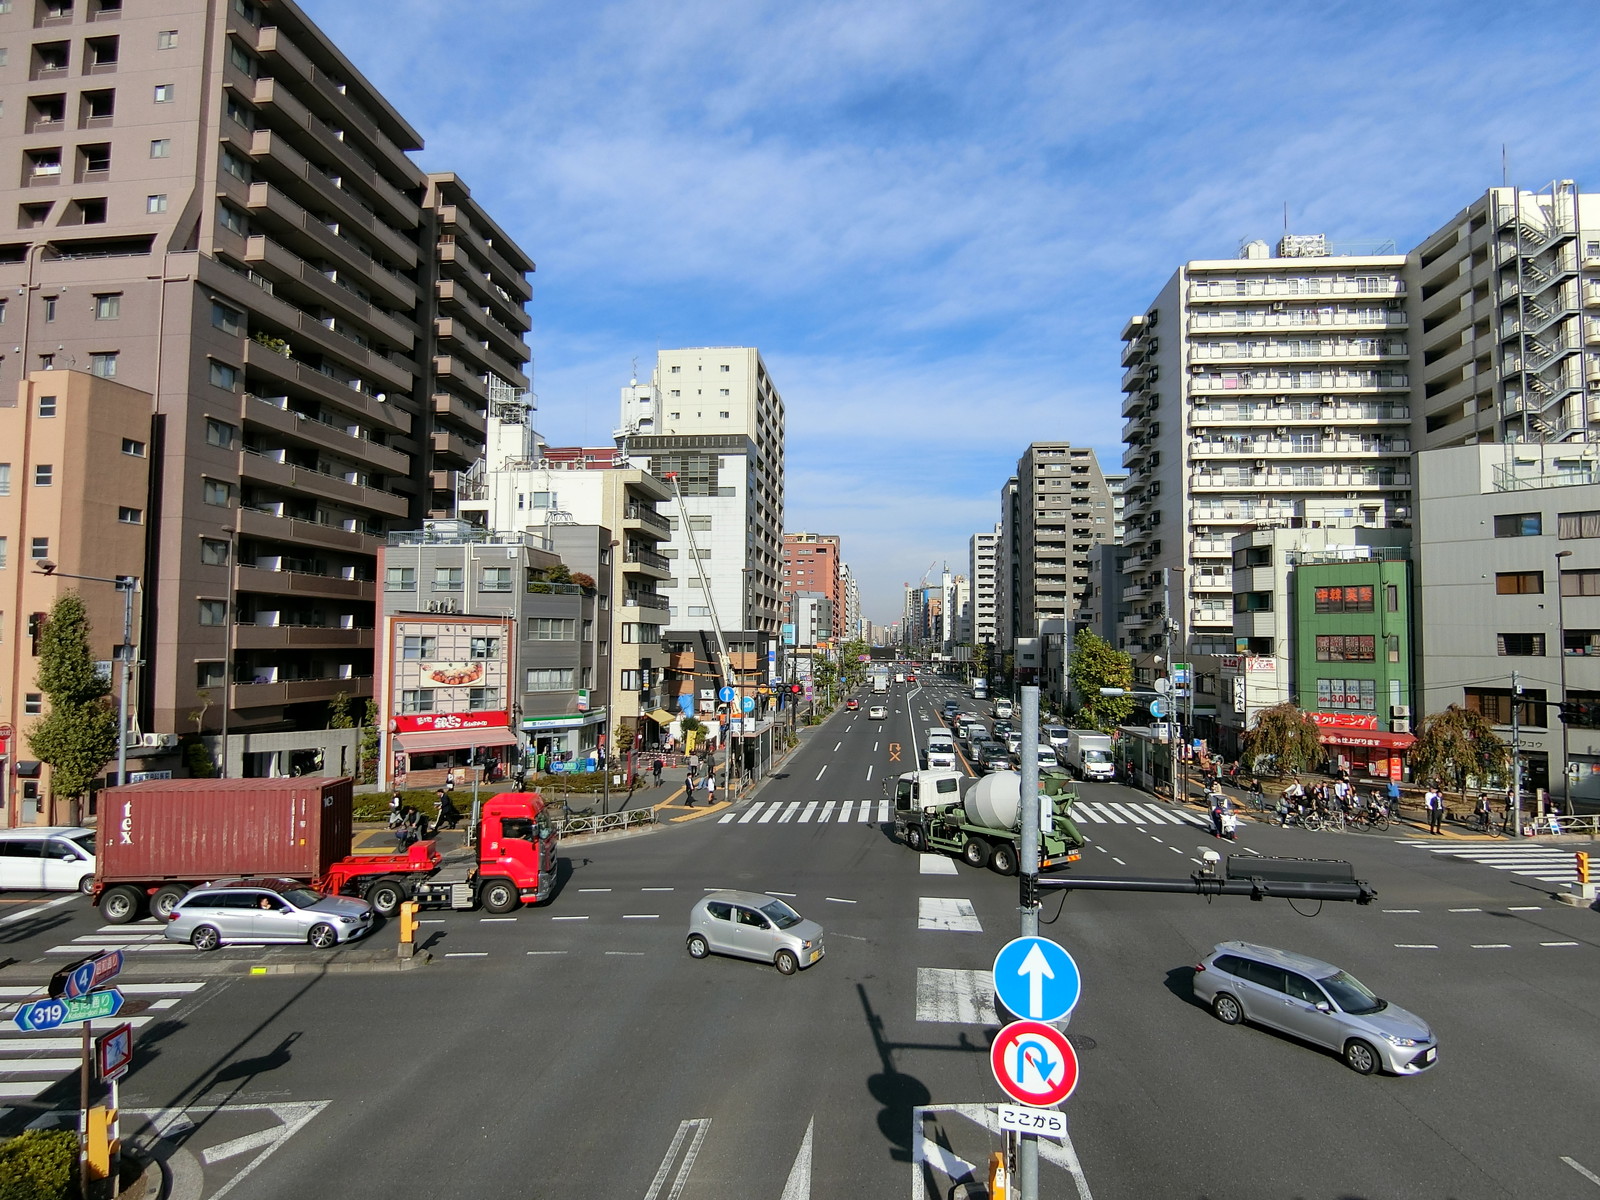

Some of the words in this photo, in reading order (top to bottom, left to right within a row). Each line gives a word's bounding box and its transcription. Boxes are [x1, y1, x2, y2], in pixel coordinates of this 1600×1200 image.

[1321, 716, 1366, 726] クリーニング
[120, 800, 133, 845] tex
[80, 968, 89, 986] 4
[34, 1004, 62, 1023] 319
[1003, 1110, 1062, 1131] ここから
